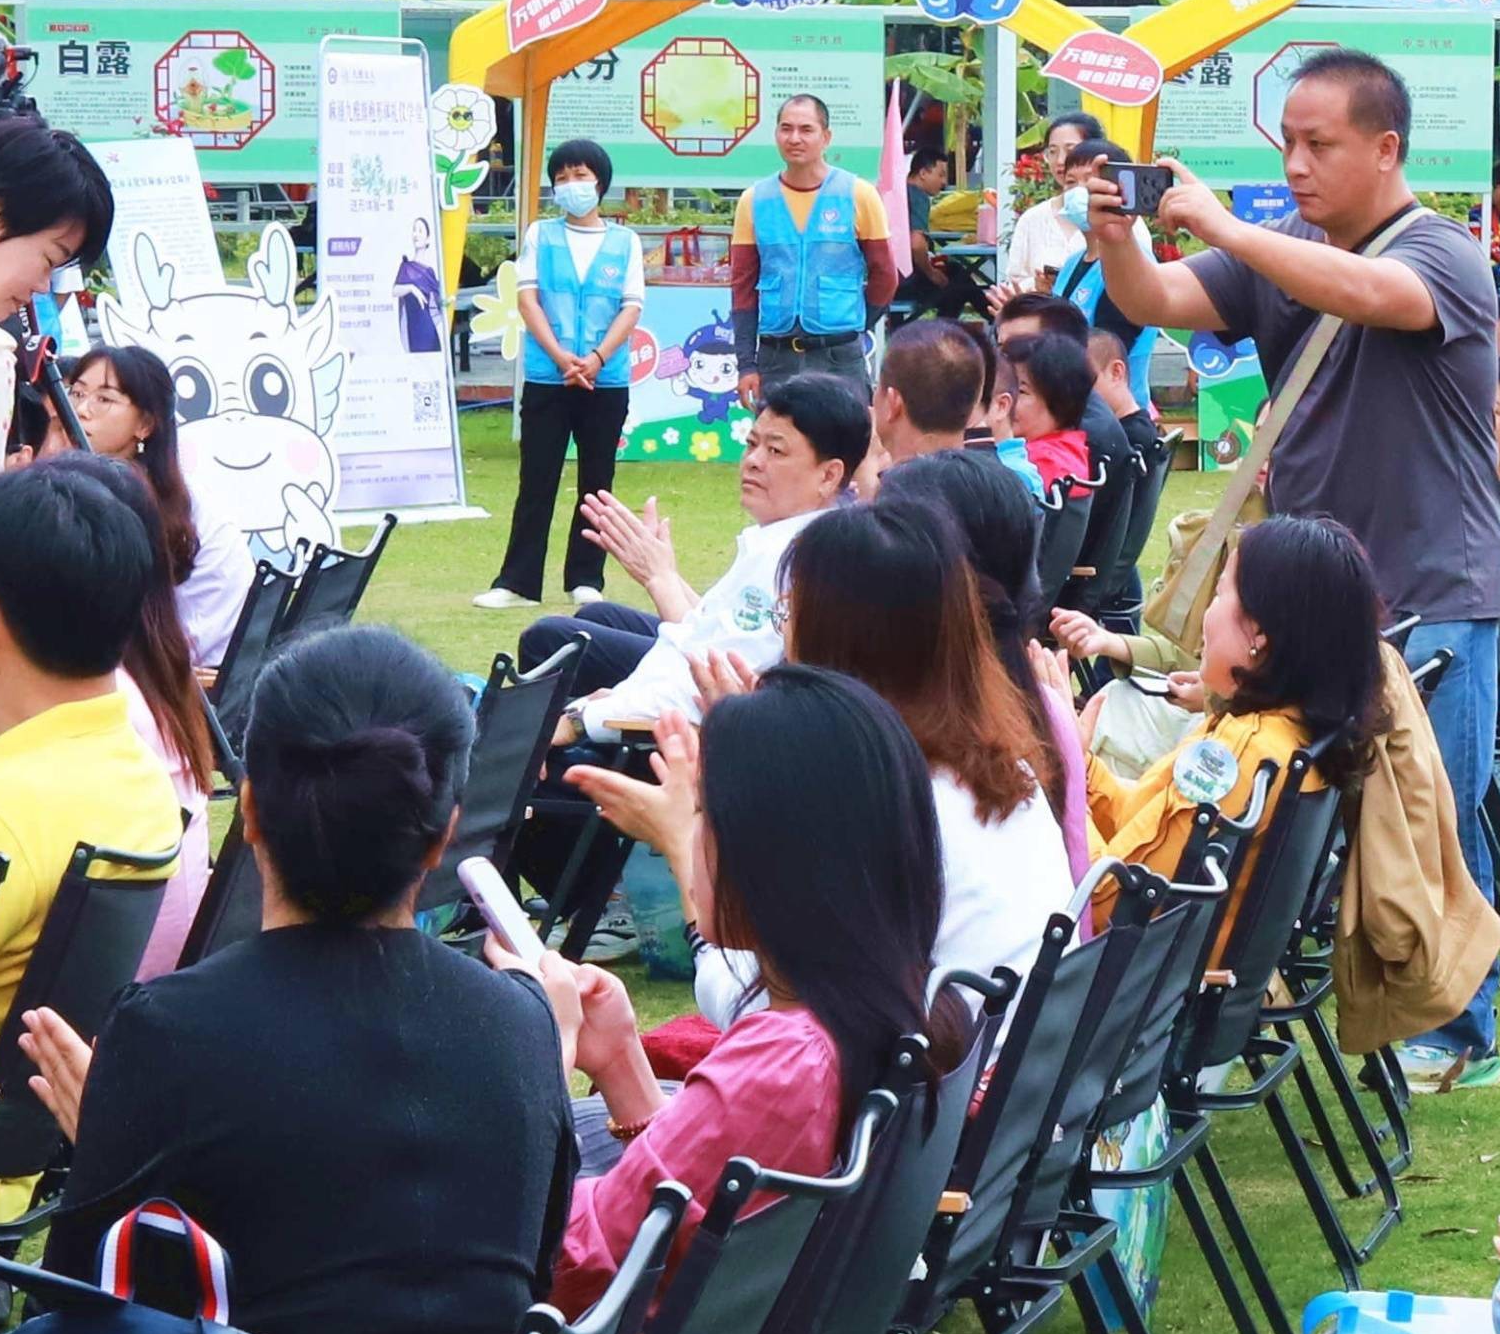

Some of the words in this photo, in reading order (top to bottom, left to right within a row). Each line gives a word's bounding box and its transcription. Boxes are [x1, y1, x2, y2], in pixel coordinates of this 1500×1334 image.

[58, 40, 131, 75] 白露
[1062, 48, 1128, 70] 万物新生
